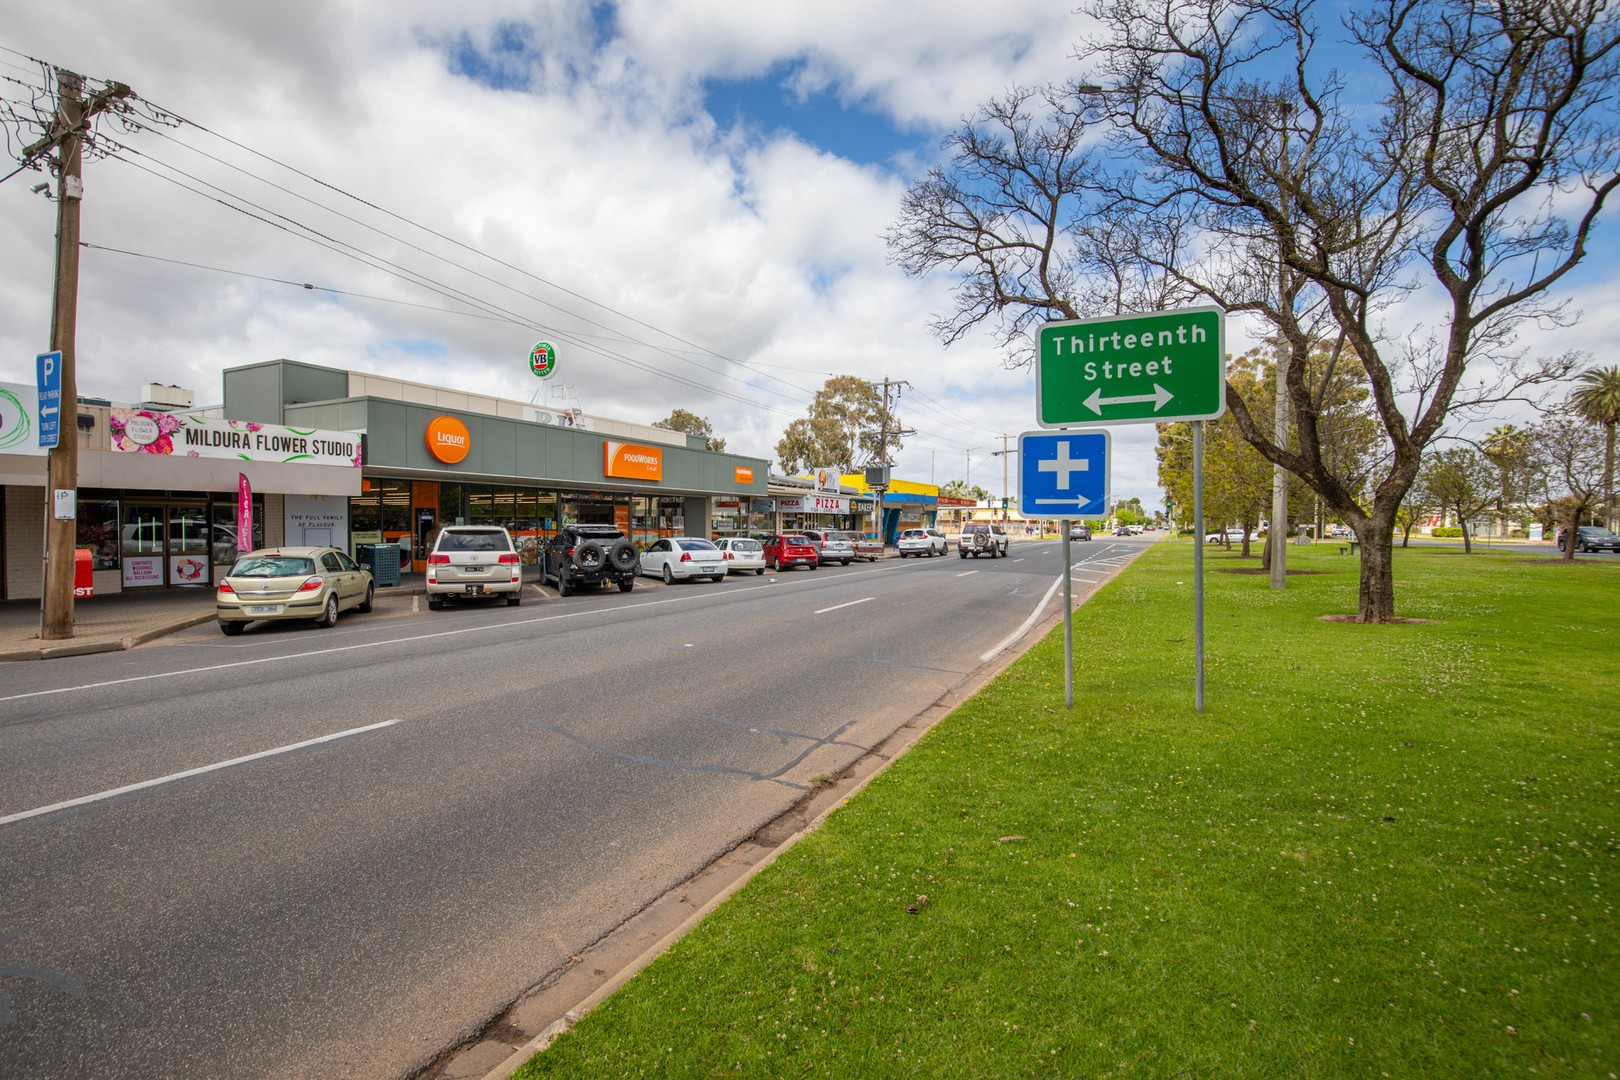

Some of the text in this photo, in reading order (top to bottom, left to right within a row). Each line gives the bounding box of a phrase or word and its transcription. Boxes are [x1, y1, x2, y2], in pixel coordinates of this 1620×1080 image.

[1053, 324, 1206, 355] Thirteenth
[534, 354, 547, 364] VB
[1084, 356, 1173, 381] Street
[44, 358, 54, 387] P
[186, 428, 353, 458] MILDURA FLOWER STUDIO
[437, 431, 465, 445] Liquor
[815, 498, 840, 509] PIZZA
